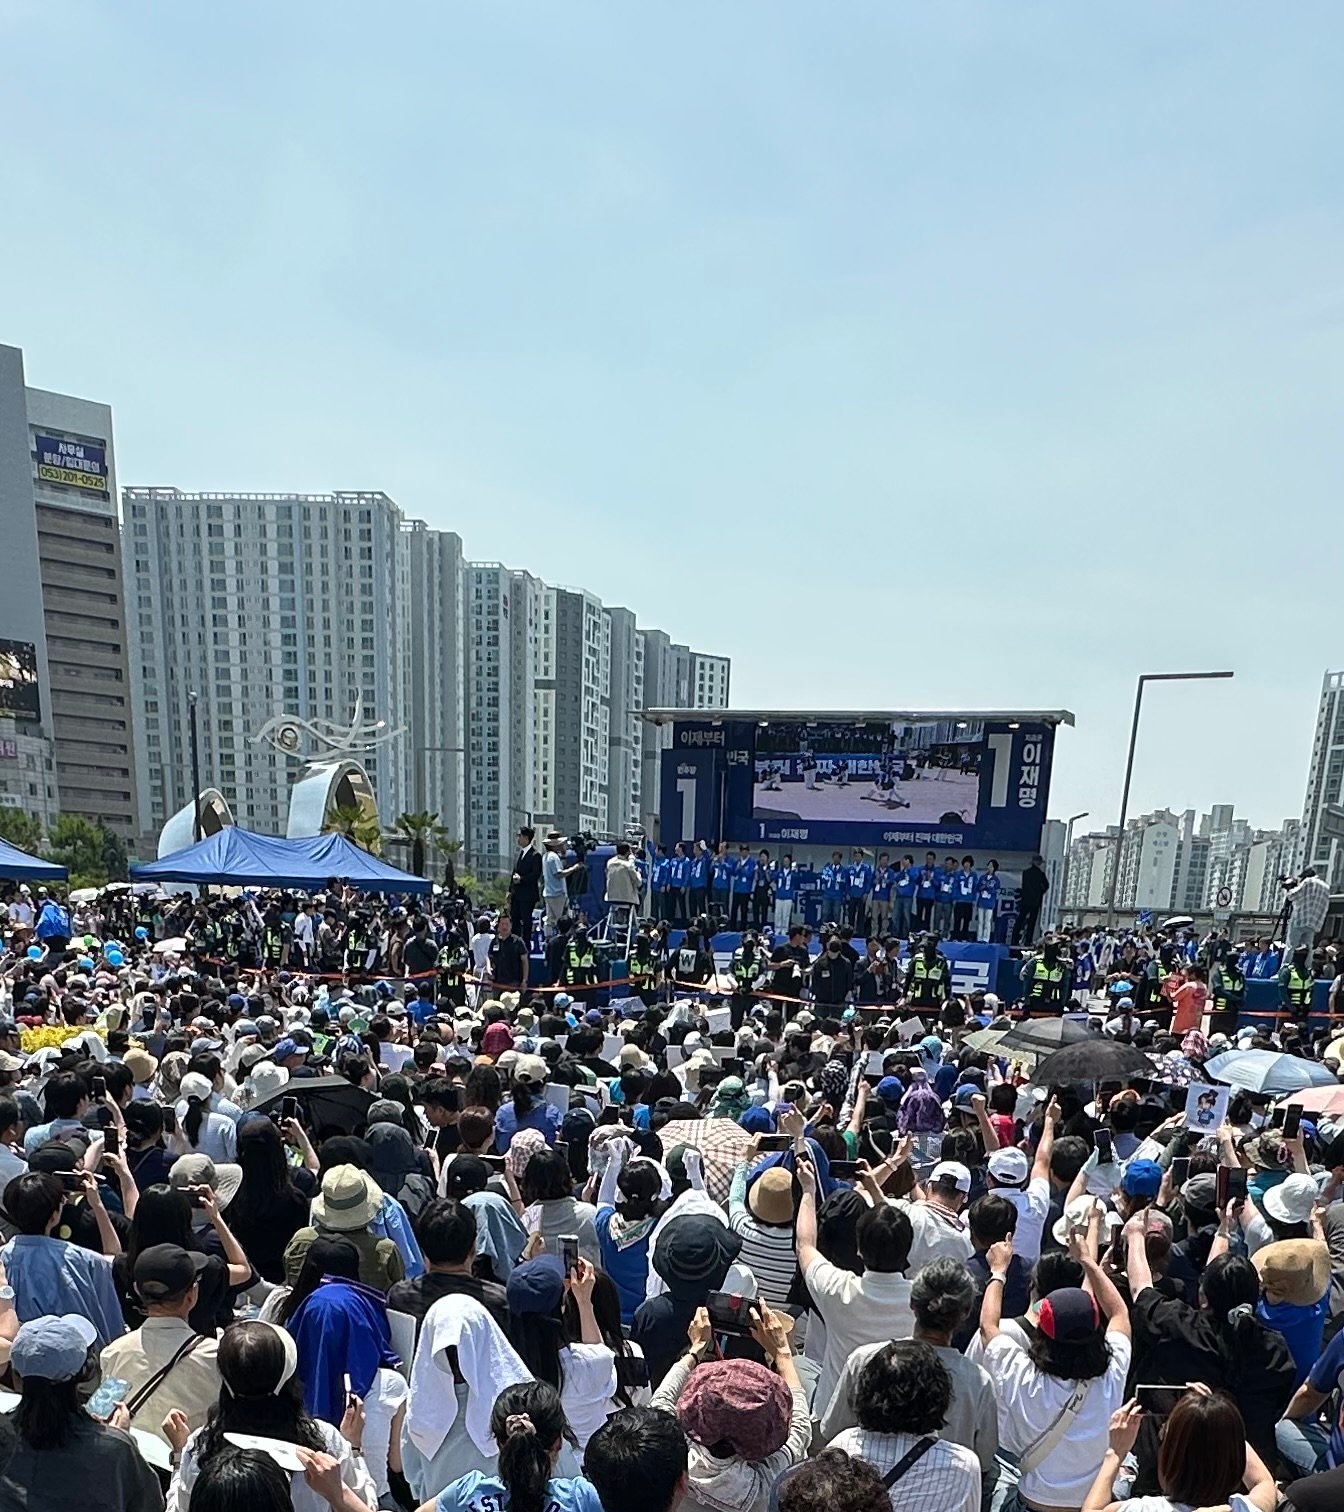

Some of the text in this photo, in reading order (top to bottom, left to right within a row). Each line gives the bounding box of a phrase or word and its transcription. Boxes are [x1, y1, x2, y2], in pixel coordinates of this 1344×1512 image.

[681, 731, 725, 747] 이제부터
[987, 734, 1013, 808] 1
[1018, 743, 1041, 808] 이재명
[676, 778, 697, 842] 1
